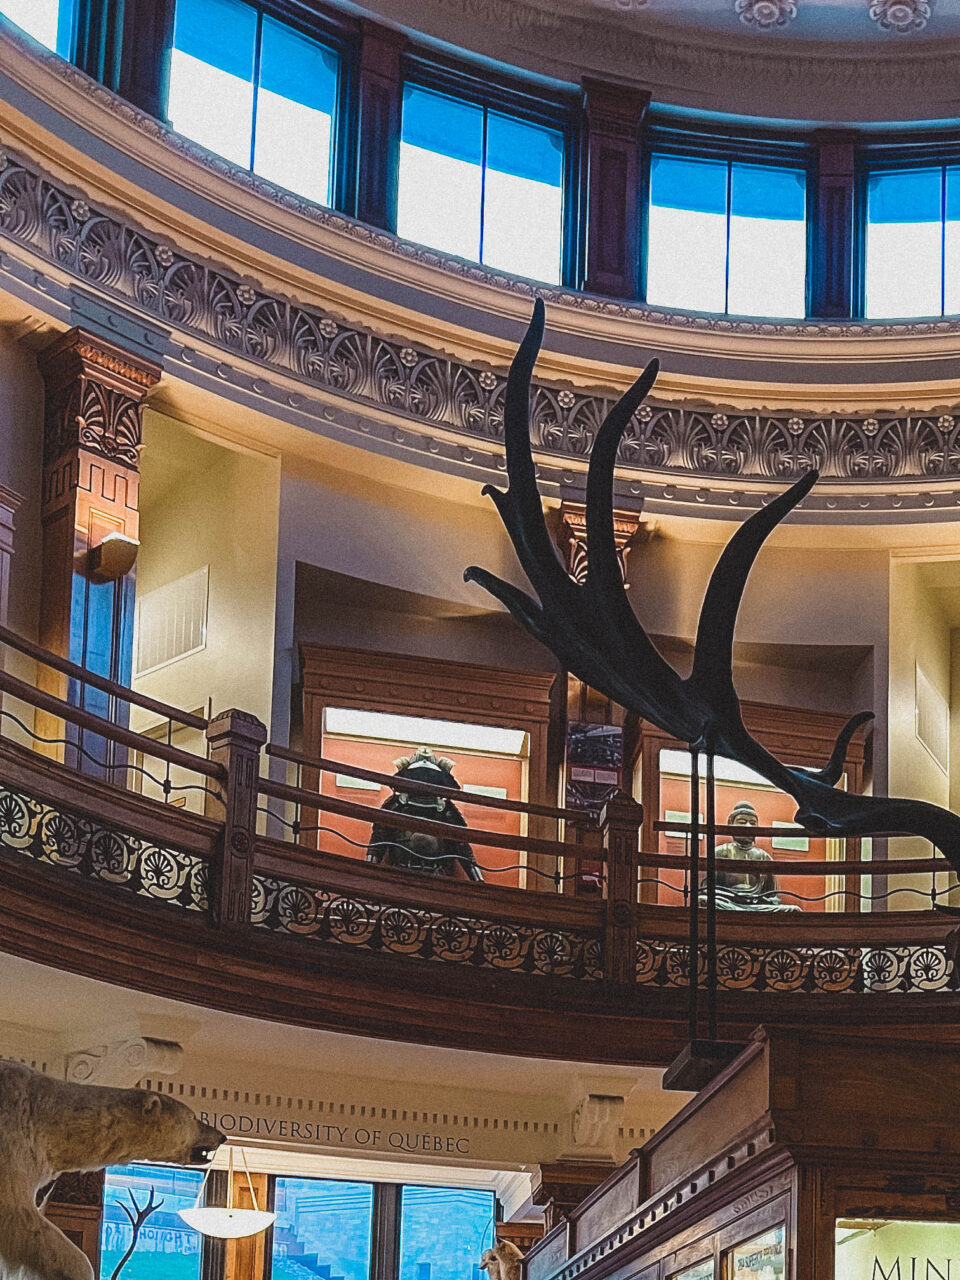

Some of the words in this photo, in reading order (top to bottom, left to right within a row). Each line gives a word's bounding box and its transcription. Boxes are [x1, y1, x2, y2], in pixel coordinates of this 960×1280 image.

[200, 1111, 348, 1143] BIODIVERSITY
[354, 1128, 382, 1146] OF
[388, 1131, 471, 1155] QUÉBEC
